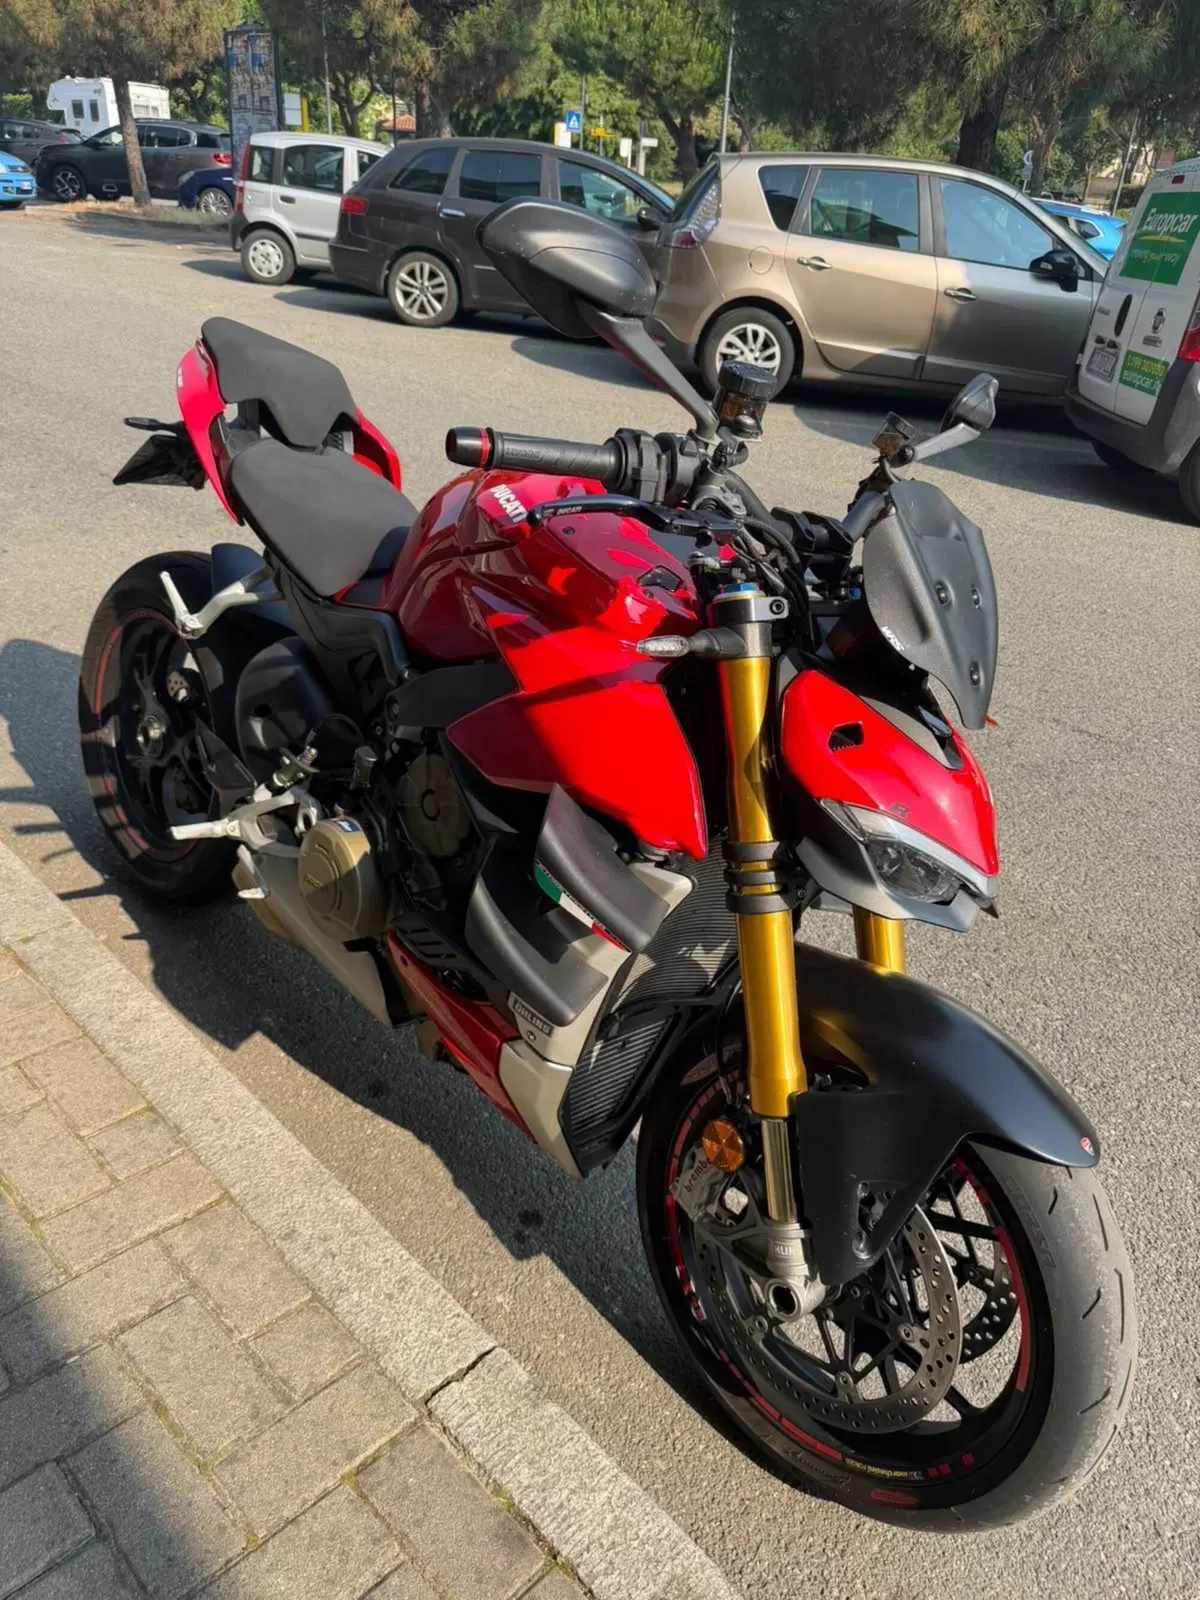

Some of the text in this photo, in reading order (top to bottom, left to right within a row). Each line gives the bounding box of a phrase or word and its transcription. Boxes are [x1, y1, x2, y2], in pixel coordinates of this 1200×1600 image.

[1142, 208, 1199, 236] Europcar
[490, 484, 529, 523] DUCATI
[556, 506, 582, 516] DUCATI
